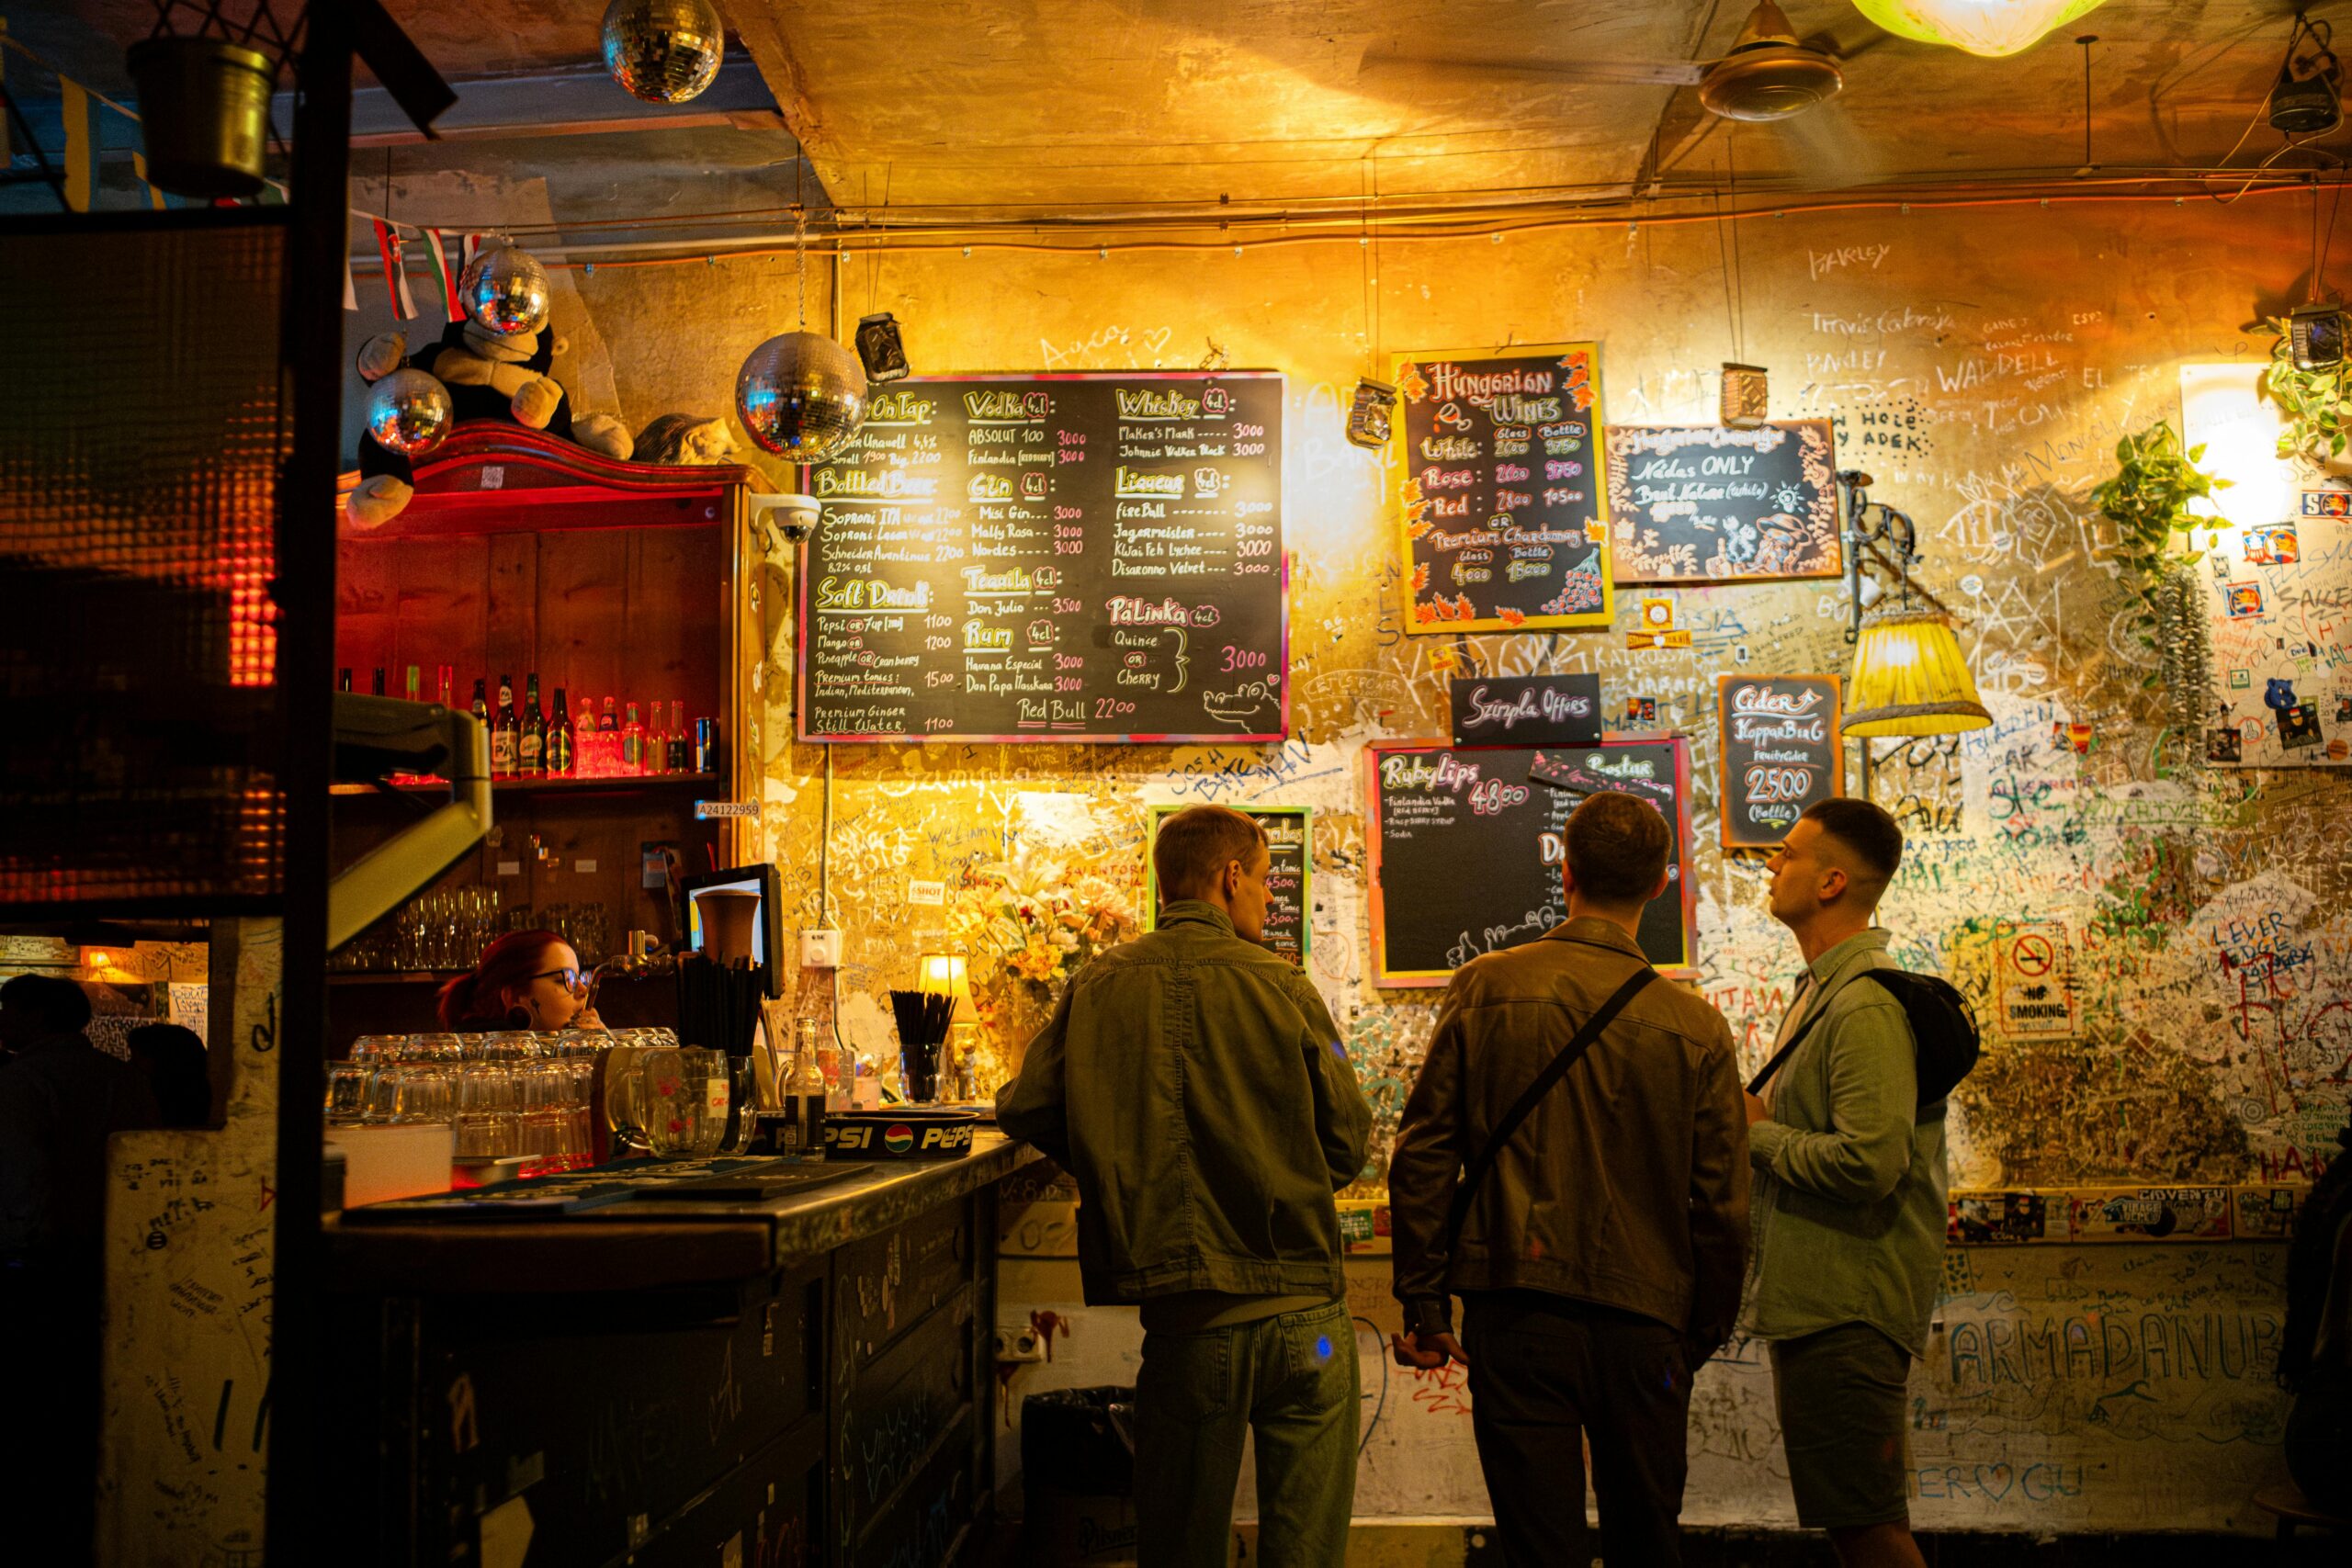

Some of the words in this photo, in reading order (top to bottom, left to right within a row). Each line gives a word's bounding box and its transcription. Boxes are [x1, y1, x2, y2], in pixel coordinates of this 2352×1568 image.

[968, 429, 1016, 446] ABSOLUT
[1022, 429, 1045, 444] 100
[1057, 430, 1086, 446] 3000
[1233, 423, 1264, 439] 3000
[831, 453, 859, 465] Small
[911, 452, 941, 465] 2200
[968, 449, 1016, 466] Finlandia
[1057, 449, 1085, 464] 3000
[1232, 444, 1264, 457] 3000
[1702, 456, 1755, 475] ONLY
[967, 472, 1013, 499] Gin
[1054, 506, 1082, 520] 3000
[1235, 501, 1273, 518] 3000
[1054, 524, 1082, 538] 3000
[1235, 522, 1273, 538] 3000
[1054, 540, 1083, 555] 3000
[1428, 528, 1501, 551] Premium
[1237, 540, 1272, 558] 3000
[1234, 561, 1270, 575] 3000
[1452, 563, 1491, 586] 4000
[815, 576, 865, 608] Soft
[967, 600, 991, 615] Don
[994, 600, 1024, 616] Julio
[1052, 598, 1081, 614] 3500
[817, 616, 846, 635] Pepsi
[923, 614, 952, 629] 1100
[962, 618, 1013, 648] Rum
[818, 635, 846, 651] Mango
[924, 636, 952, 650] 1200
[816, 651, 856, 668] Pineapple
[1052, 652, 1083, 670] 3000
[1220, 646, 1266, 672] 3000
[924, 671, 954, 687] 1500
[1054, 676, 1082, 692] 3000
[1117, 670, 1159, 690] Cherry
[815, 706, 865, 718] Premium
[1016, 698, 1047, 721] Red
[1050, 700, 1086, 720] Bull
[1095, 698, 1136, 719] 2200
[817, 718, 848, 733] Still
[855, 720, 902, 732] Water
[924, 717, 954, 732] 1100
[1745, 765, 1813, 803] 2500
[1469, 779, 1530, 816] 4800
[2213, 912, 2290, 945] LEVER
[2026, 986, 2047, 1000] NO
[2009, 1003, 2067, 1019] SMOKING
